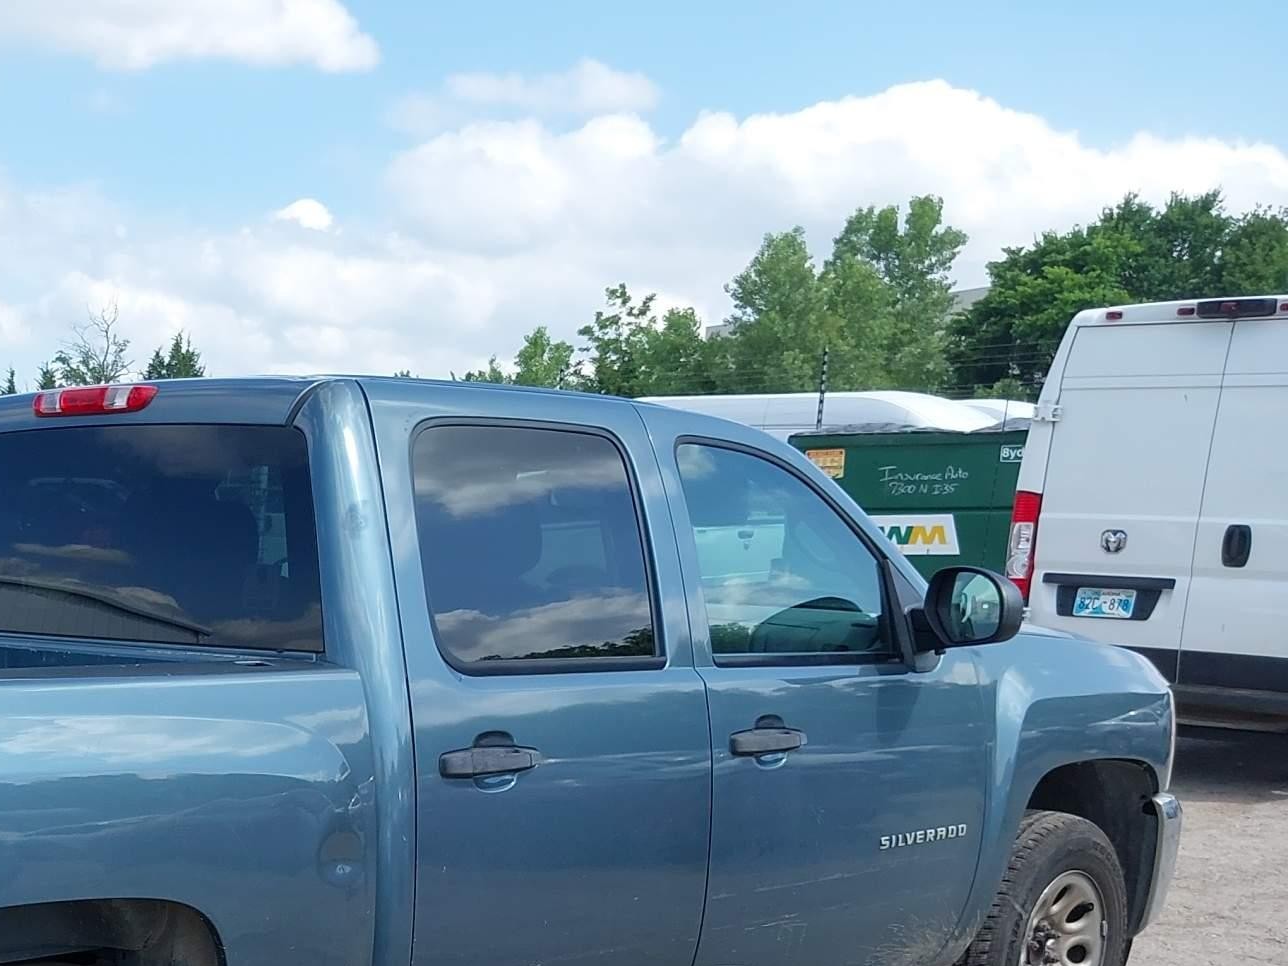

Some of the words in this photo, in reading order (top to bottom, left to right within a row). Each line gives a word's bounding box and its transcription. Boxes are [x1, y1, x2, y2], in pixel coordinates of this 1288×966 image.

[944, 466, 969, 480] Auto
[918, 483, 929, 494] N
[878, 526, 947, 545] WM
[879, 823, 967, 850] SILVERADO
